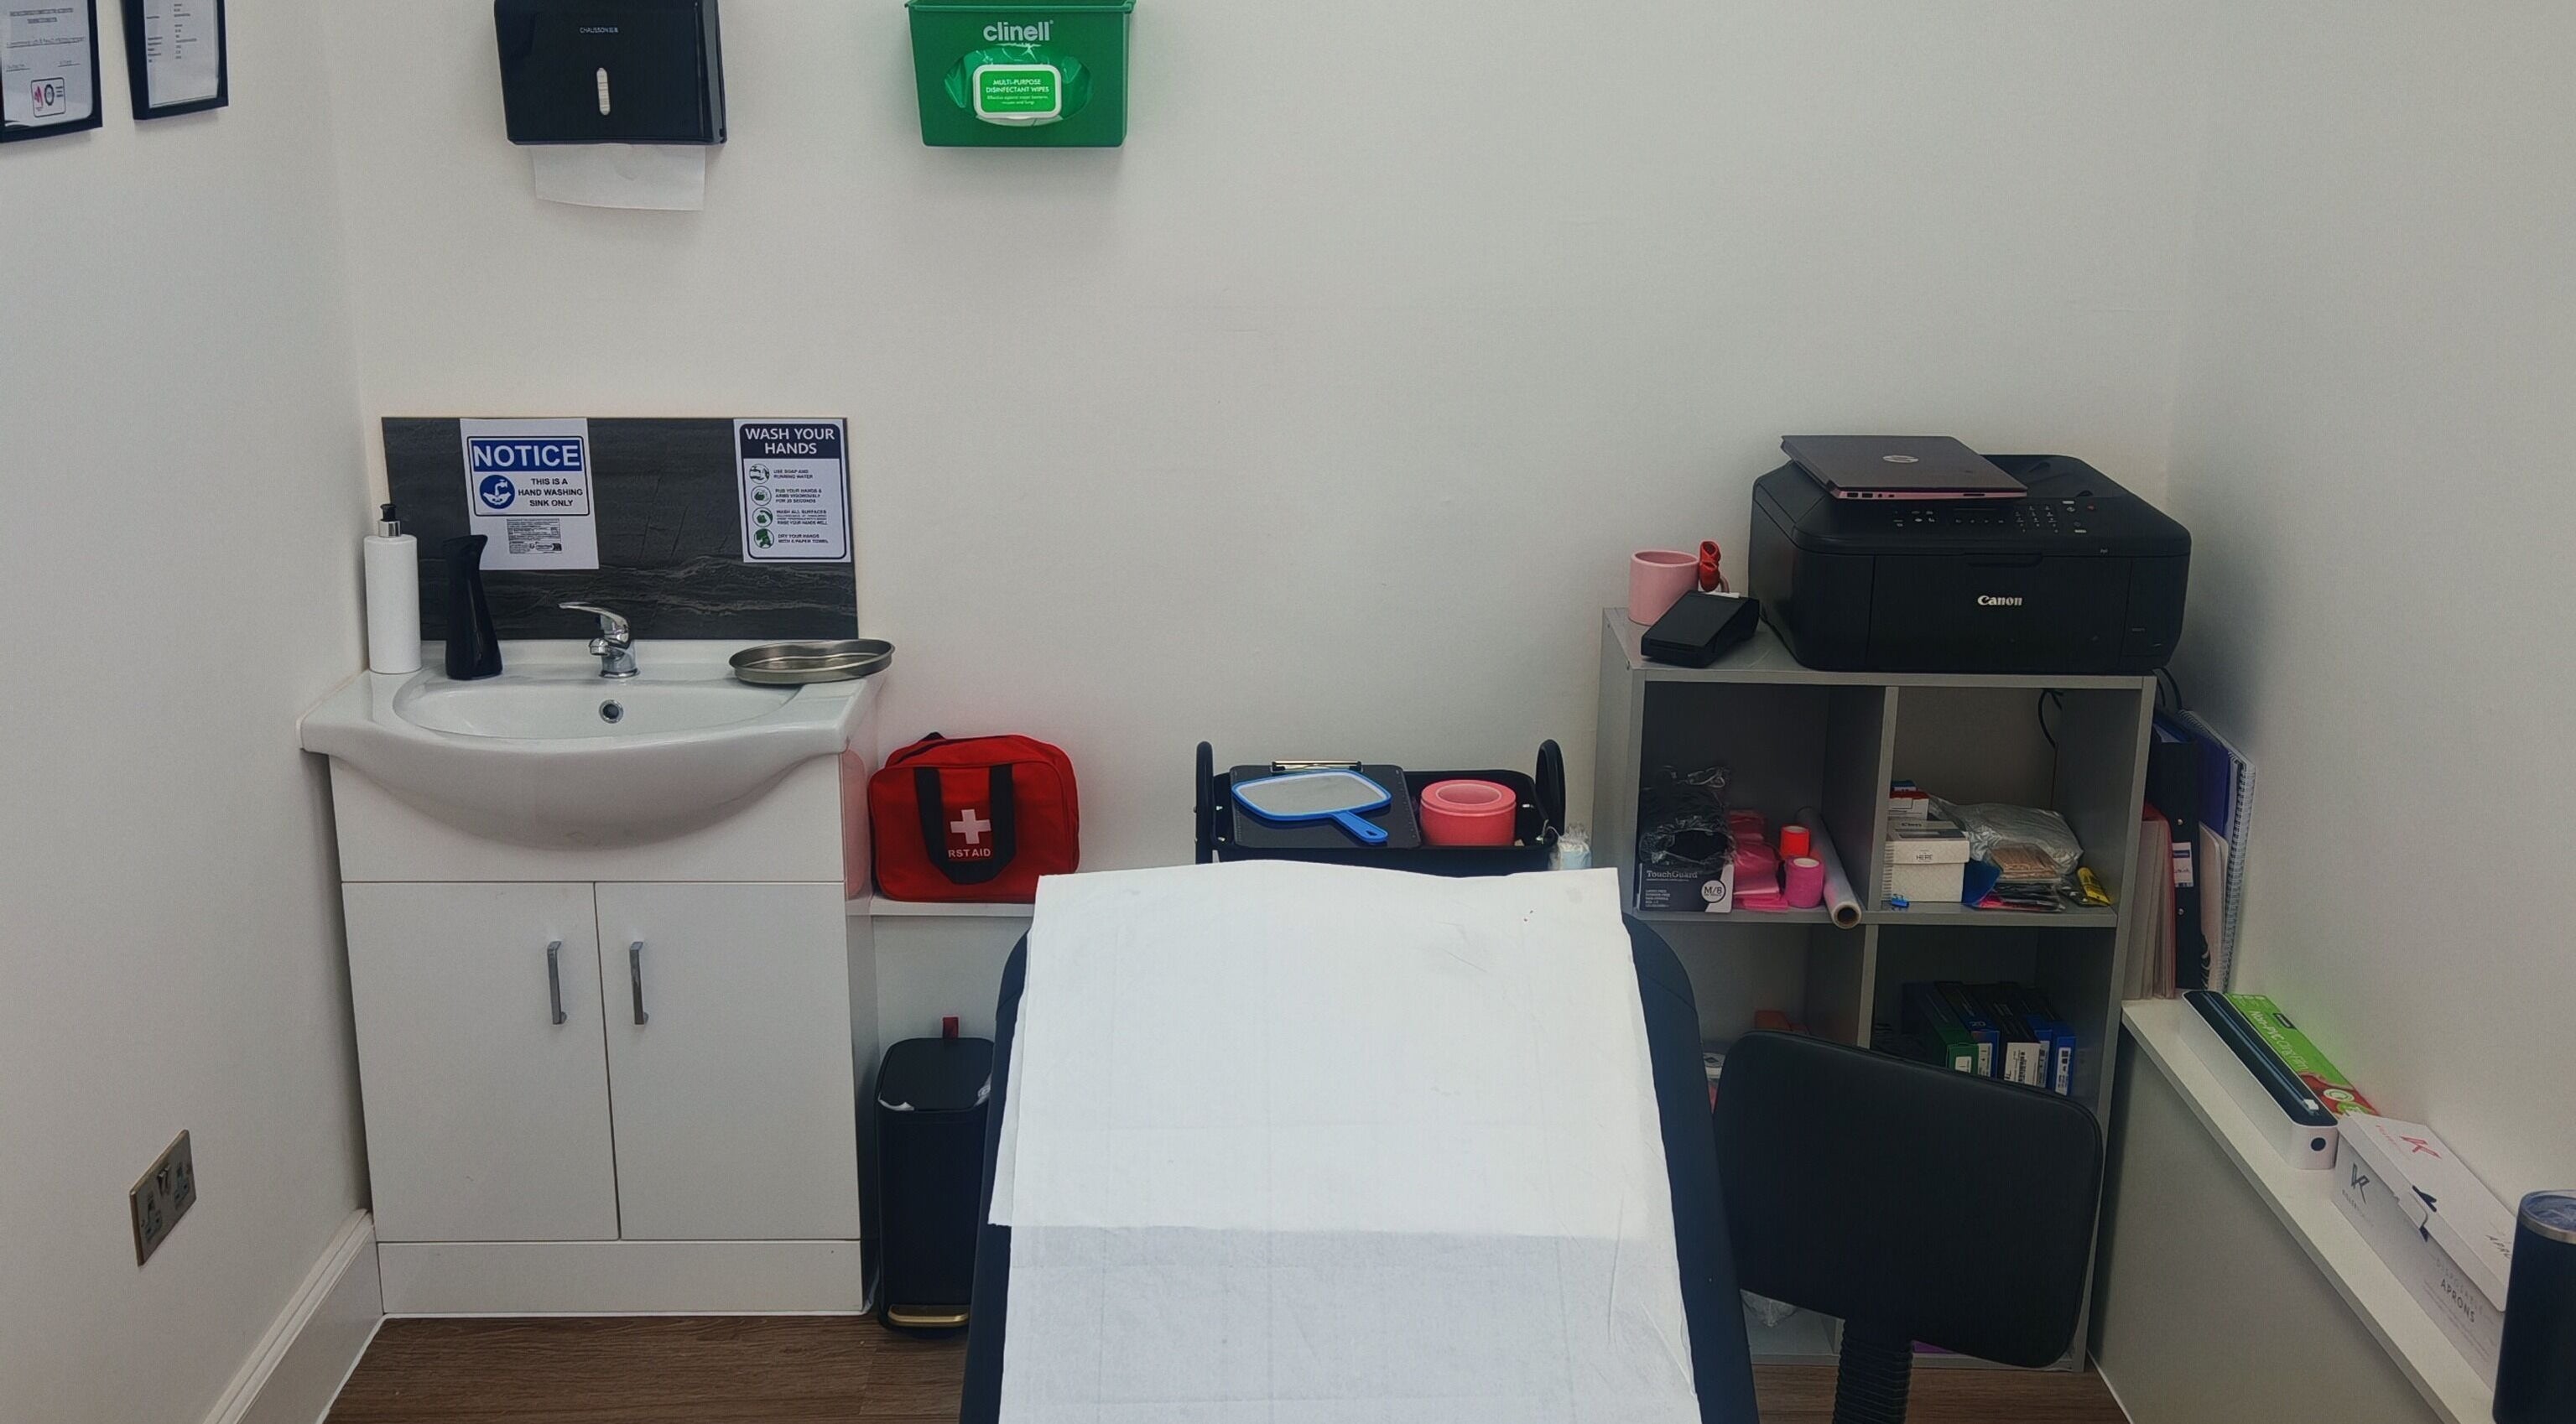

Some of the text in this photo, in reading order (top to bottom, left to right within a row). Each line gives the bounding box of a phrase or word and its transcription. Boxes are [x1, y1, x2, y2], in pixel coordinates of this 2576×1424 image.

[983, 21, 1050, 41] clinell
[745, 428, 835, 440] WASH YOUR
[764, 442, 817, 455] HANDS
[472, 444, 580, 467] NOTICE
[530, 477, 550, 486] THIS
[552, 477, 560, 486] IS
[518, 488, 584, 496] HAND WASHING
[529, 499, 574, 507] SINK ONLY
[1977, 595, 2022, 605] Canon
[948, 848, 991, 858] RST AID
[1646, 870, 1698, 879] TouchGuard
[2440, 1278, 2475, 1323] APRONS
